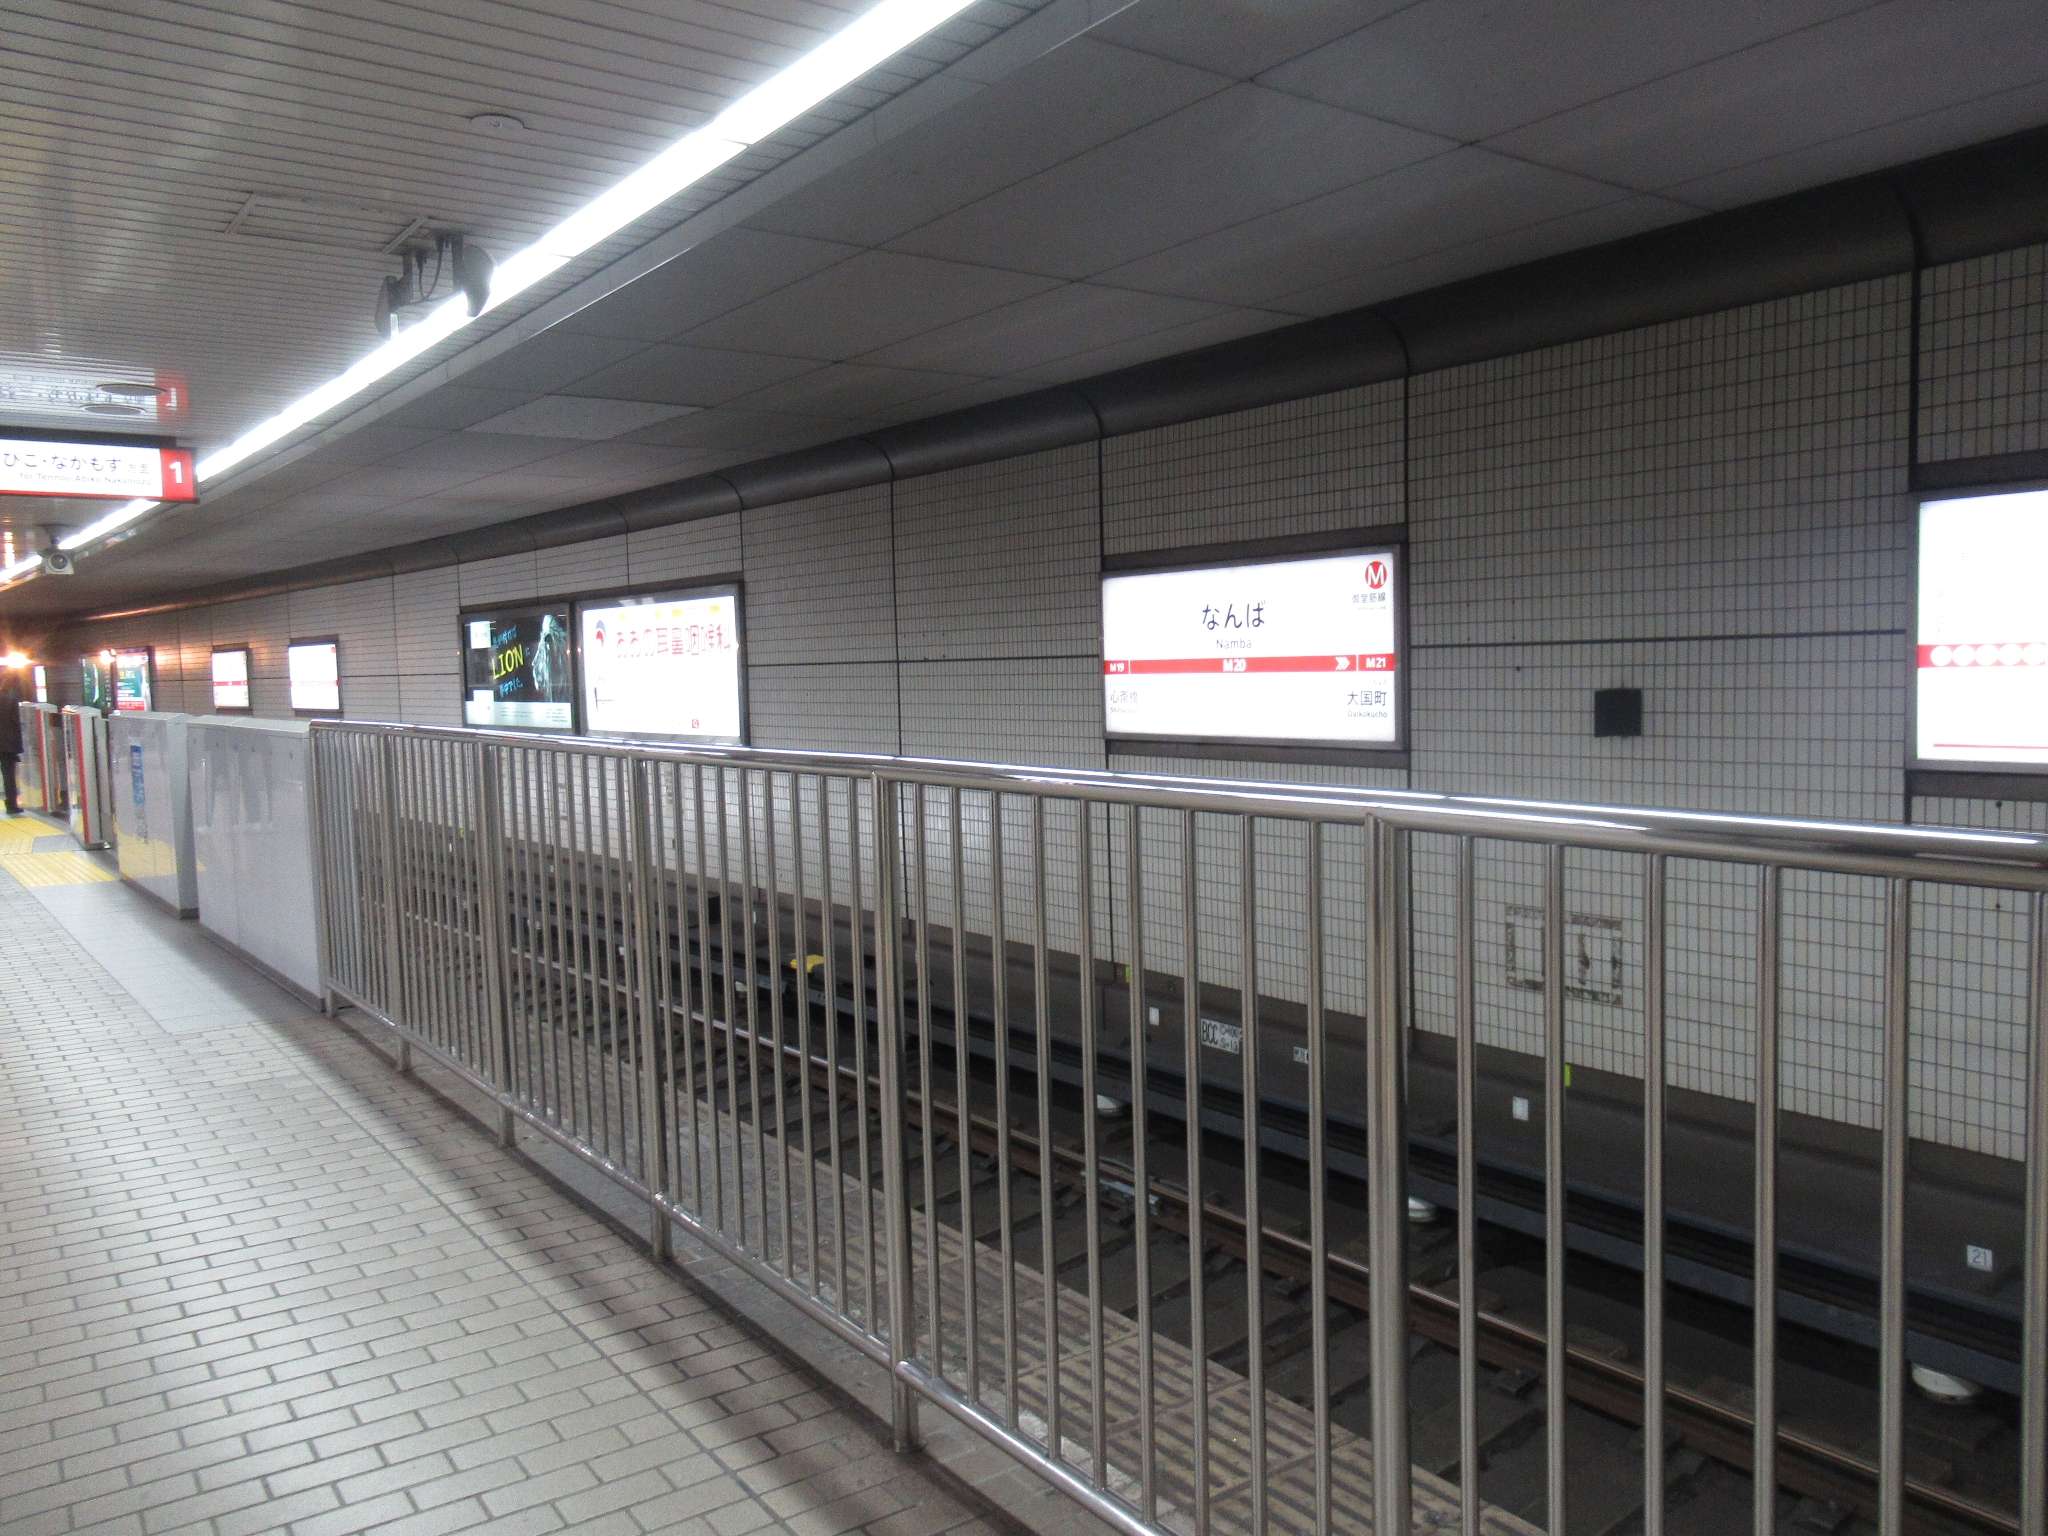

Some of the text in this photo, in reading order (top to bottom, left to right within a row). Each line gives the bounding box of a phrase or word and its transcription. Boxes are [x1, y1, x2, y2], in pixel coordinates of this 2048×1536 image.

[169, 461, 183, 484] 1
[1367, 563, 1386, 587] M
[1202, 600, 1266, 630] なんば
[1216, 638, 1252, 649] Namba
[491, 643, 524, 680] LION
[1222, 659, 1246, 673] M20
[1366, 657, 1386, 669] M21
[1347, 690, 1387, 706] 大国町
[1972, 1248, 1987, 1265] 21
